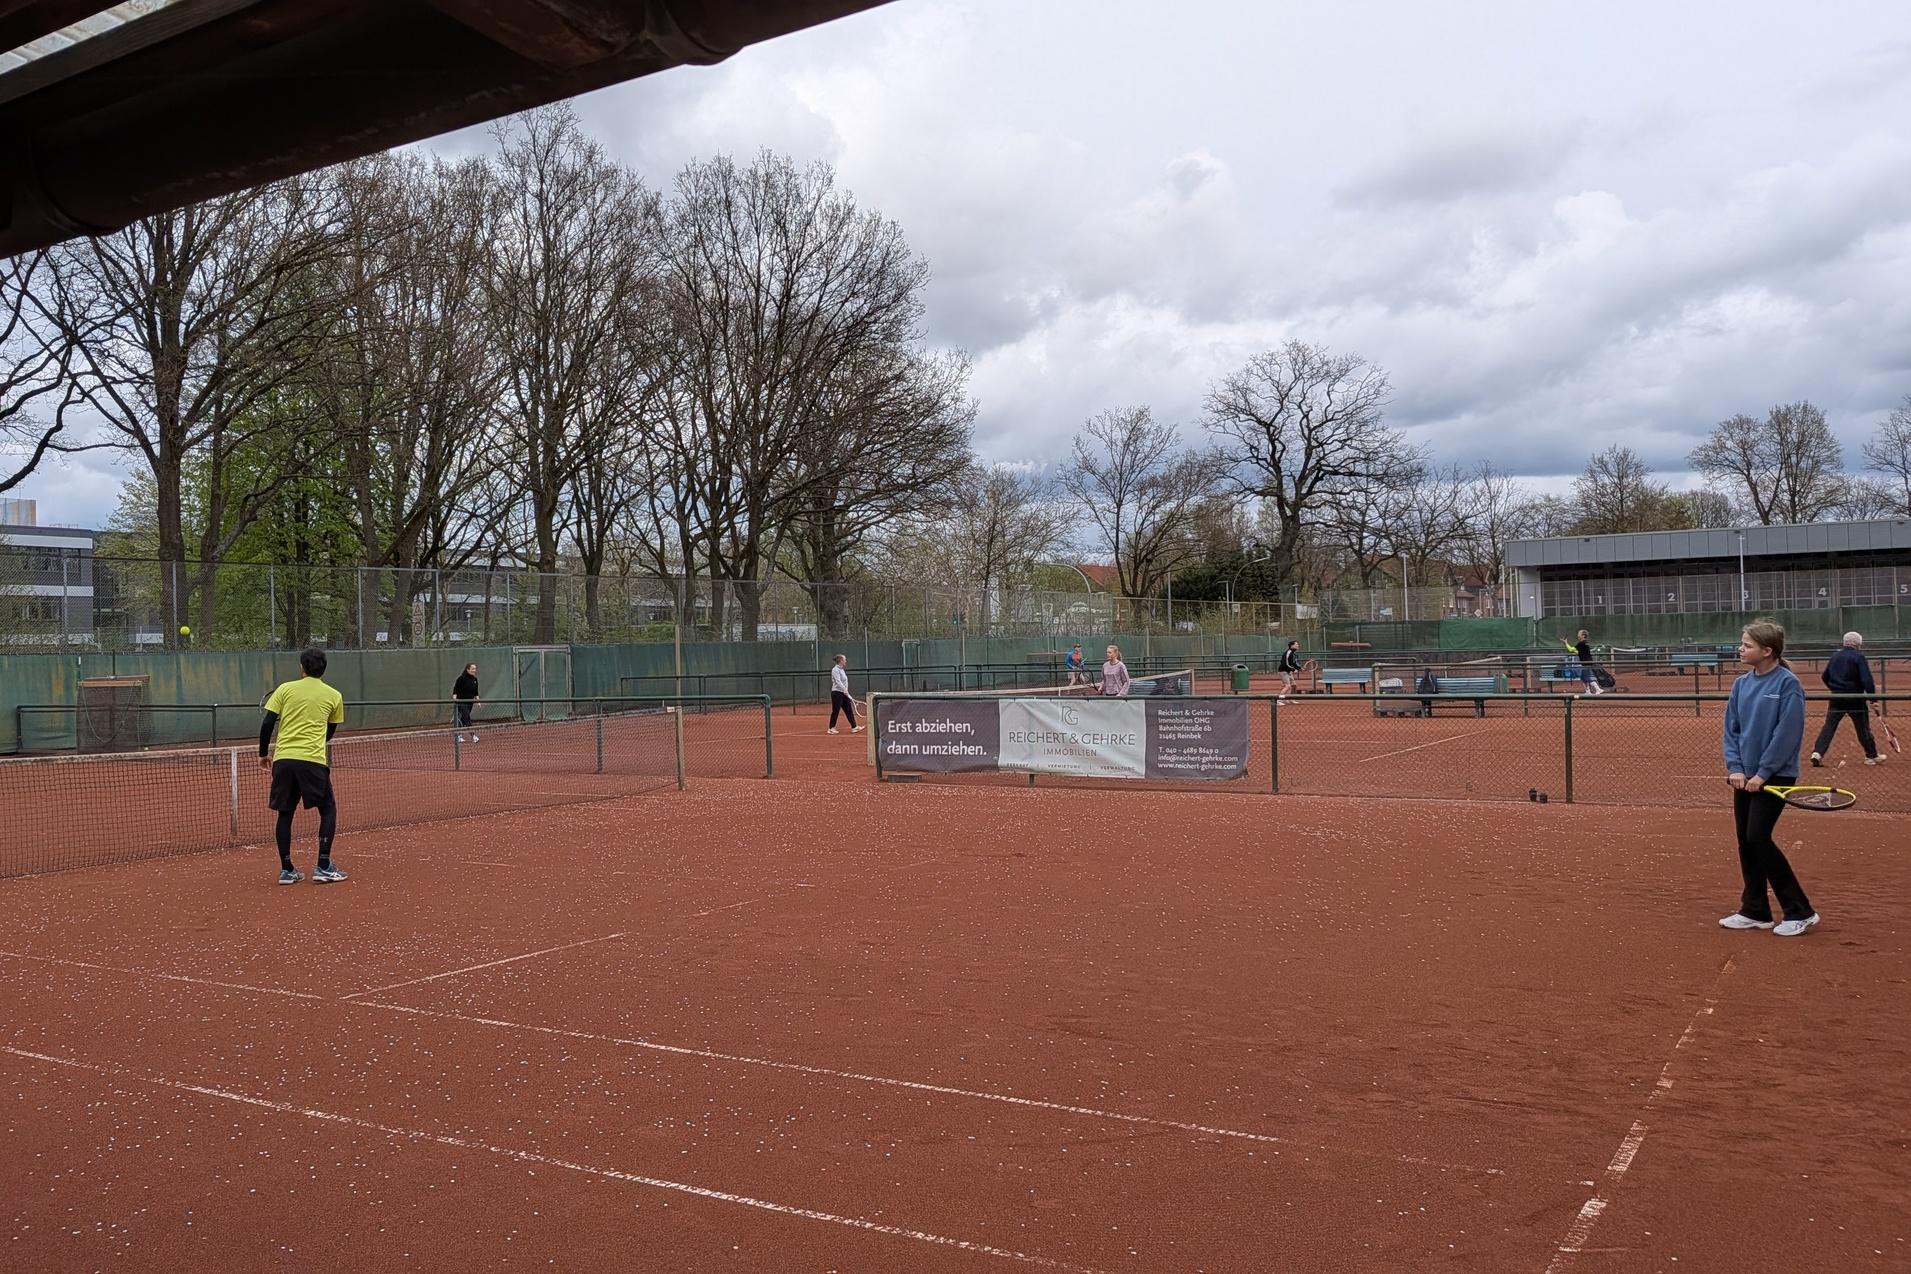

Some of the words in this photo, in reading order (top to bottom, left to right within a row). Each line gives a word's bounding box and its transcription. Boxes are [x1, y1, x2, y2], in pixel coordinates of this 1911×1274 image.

[1818, 587, 1827, 596] 4
[1900, 584, 1908, 593] 5
[1667, 592, 1676, 602] 2
[887, 720, 912, 733] Erst
[915, 718, 975, 736] abziehen,
[1009, 731, 1067, 744] REICHERT
[1069, 734, 1079, 744] &
[1081, 733, 1136, 746] GEHRKE
[886, 740, 918, 754] dann
[922, 740, 987, 756] umziehen.
[1043, 748, 1097, 757] IMMOBILIEN
[1158, 754, 1238, 763] info@reichert-gehrke.com
[1158, 762, 1237, 771] www.reichert-gehrke.com
